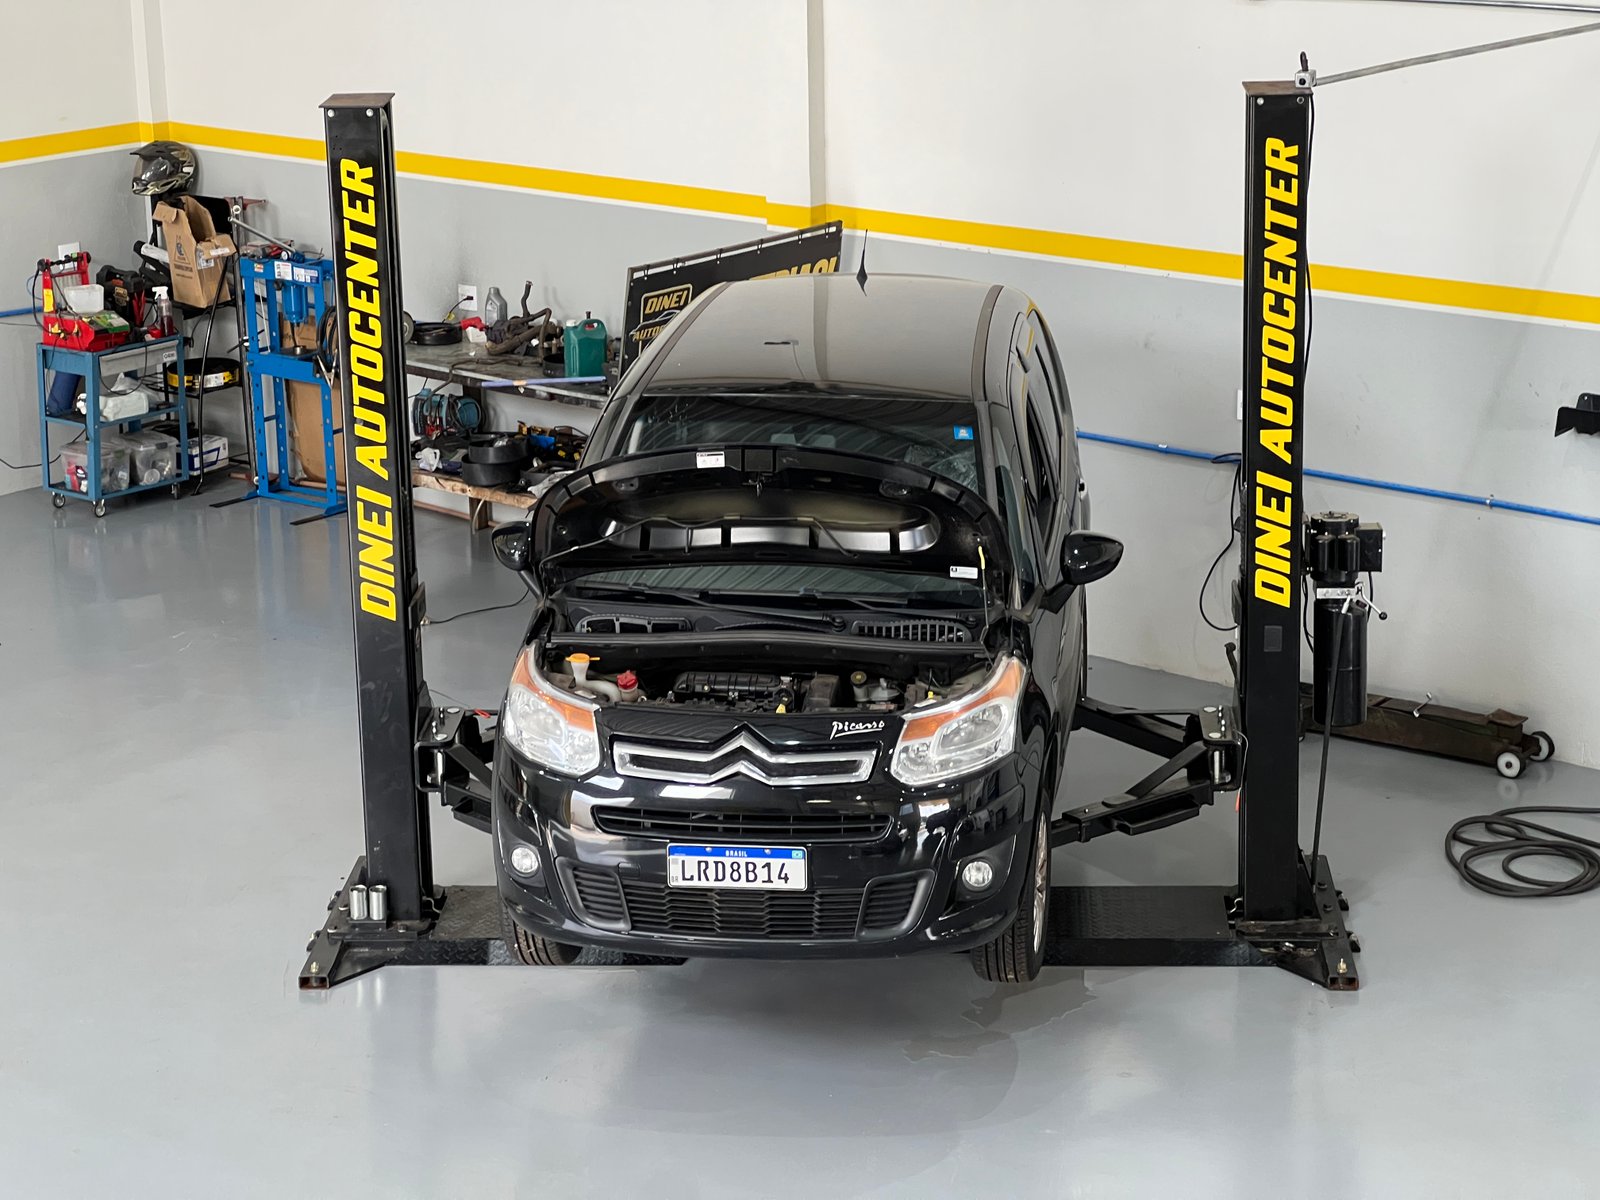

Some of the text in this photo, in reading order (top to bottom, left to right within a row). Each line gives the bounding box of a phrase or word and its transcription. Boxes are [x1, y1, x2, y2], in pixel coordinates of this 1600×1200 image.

[339, 158, 397, 622] DINEI AUTOCENTER
[644, 290, 688, 314] DINEI
[1254, 137, 1299, 608] DINEI AUTOCENTER
[681, 860, 790, 884] LRD8B14
